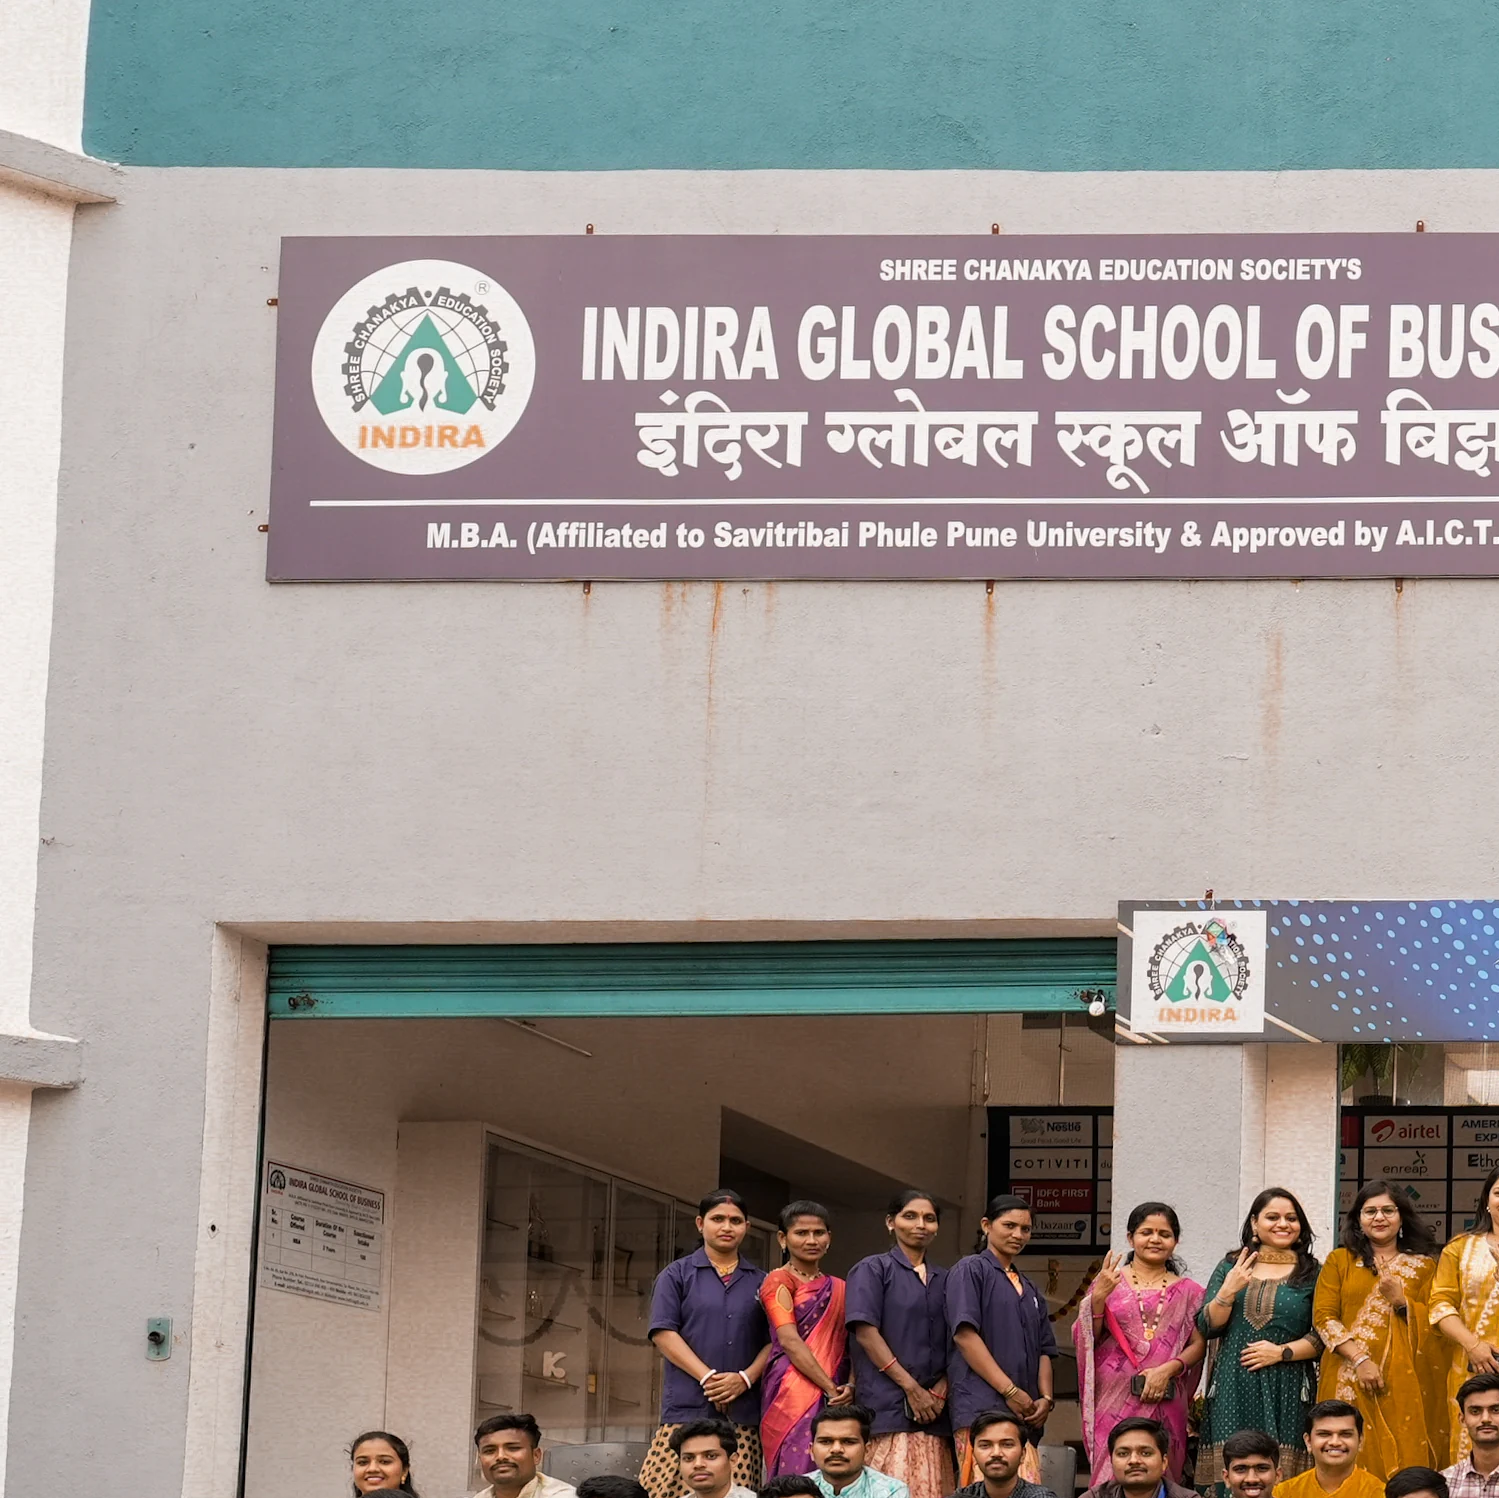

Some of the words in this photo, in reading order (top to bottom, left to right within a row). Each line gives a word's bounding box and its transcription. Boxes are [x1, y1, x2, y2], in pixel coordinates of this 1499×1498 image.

[880, 260, 956, 280] SHREE
[965, 260, 1092, 280] CHANAKYA
[1100, 259, 1232, 280] EDUCATION
[1241, 259, 1361, 280] SOCIETY'S
[583, 307, 778, 380] INDIRA
[798, 305, 1023, 380] GLOBAL
[1043, 305, 1276, 380] SCHOOL
[1296, 305, 1369, 379] OF
[358, 424, 486, 449] INDIRA
[636, 390, 808, 480] इंदिरा
[825, 389, 1038, 468] ग्लोबल
[1055, 412, 1201, 493] स्कूल
[1221, 389, 1358, 466] ऑफ
[428, 523, 516, 547] M.B.A.
[528, 523, 666, 554] (Affiliated
[677, 523, 704, 547] to
[714, 522, 848, 547] Savitribai
[859, 522, 937, 547] Phule
[948, 522, 1017, 546] Pune
[1028, 521, 1171, 553] University
[1181, 522, 1201, 546] &
[1211, 521, 1344, 552] Approved
[1355, 521, 1388, 551] by
[1158, 1007, 1238, 1023] INDIRA
[1398, 1123, 1441, 1139] airtel
[1013, 1158, 1088, 1169] COTIVITI
[1382, 1165, 1428, 1177] enreap
[289, 1177, 307, 1190] INDIRA
[308, 1182, 328, 1196] GLOBAL
[329, 1188, 349, 1201] SCHOOL
[357, 1196, 381, 1210] BUSINESS
[1036, 1189, 1061, 1198] IDFC
[1061, 1188, 1090, 1198] FIRST
[1036, 1199, 1061, 1208] Bank
